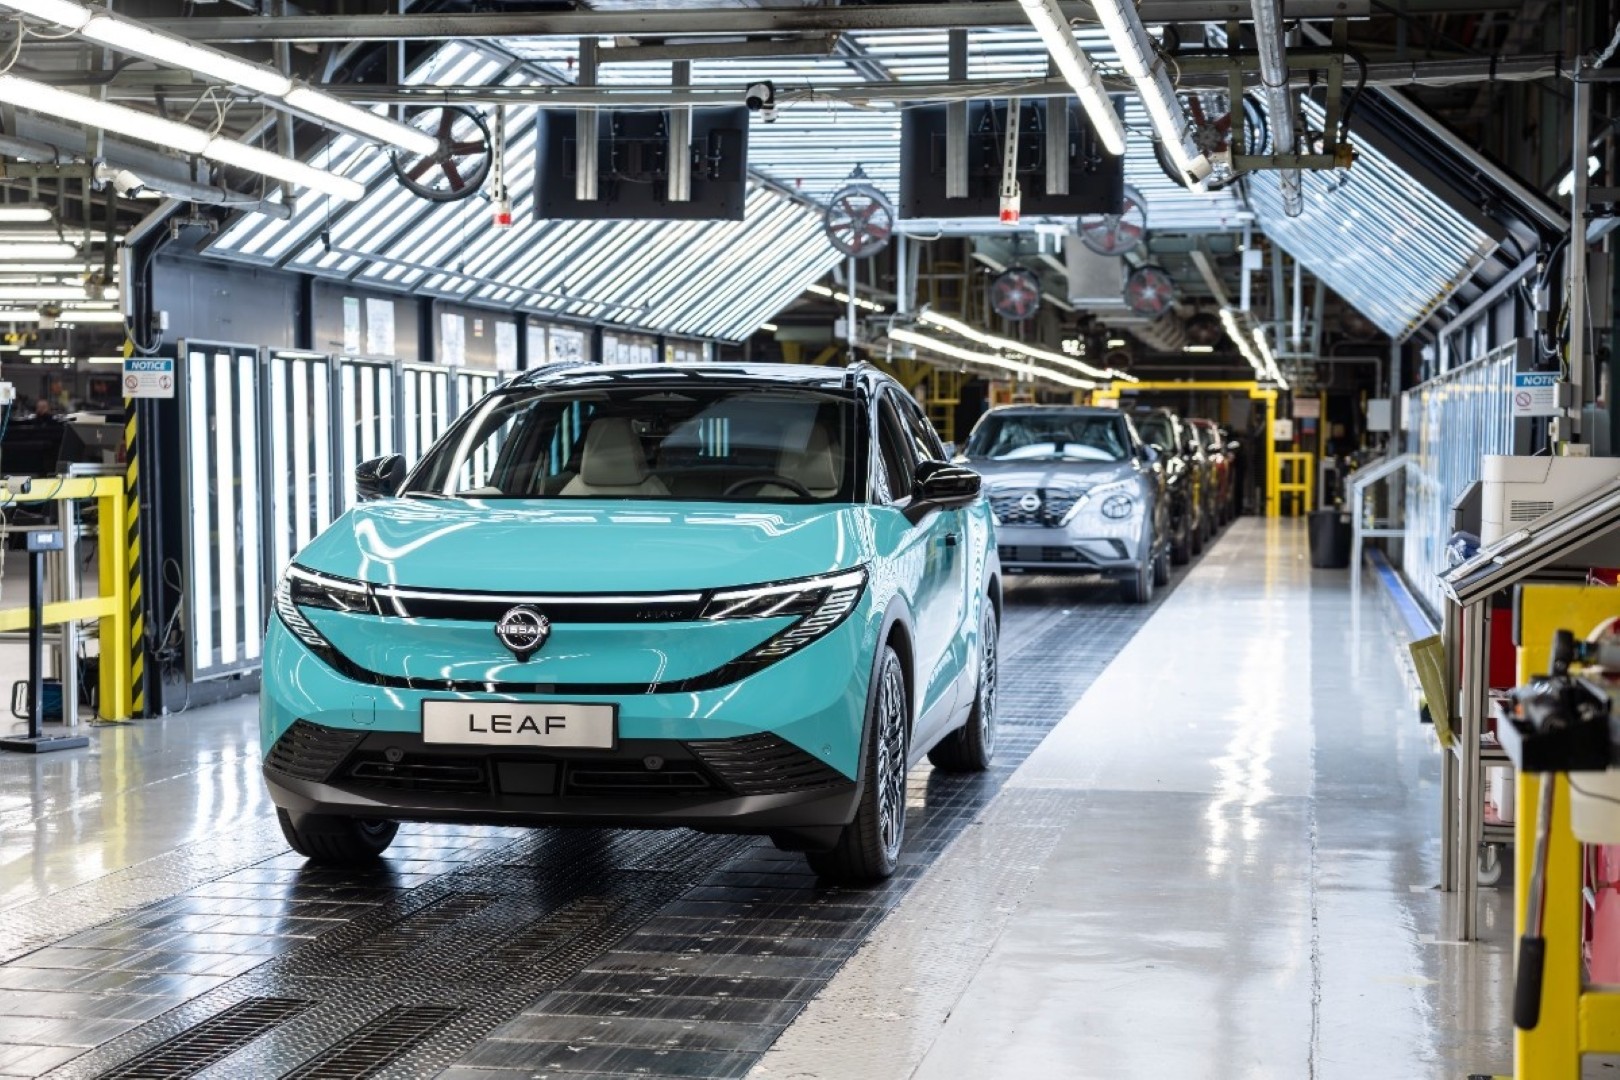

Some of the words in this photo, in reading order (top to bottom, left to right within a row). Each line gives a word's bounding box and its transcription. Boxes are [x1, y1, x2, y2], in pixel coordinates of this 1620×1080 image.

[131, 360, 166, 370] NOTICE
[1523, 375, 1559, 385] NOTIC
[497, 625, 547, 634] NISSAN
[469, 713, 566, 735] LEAF
